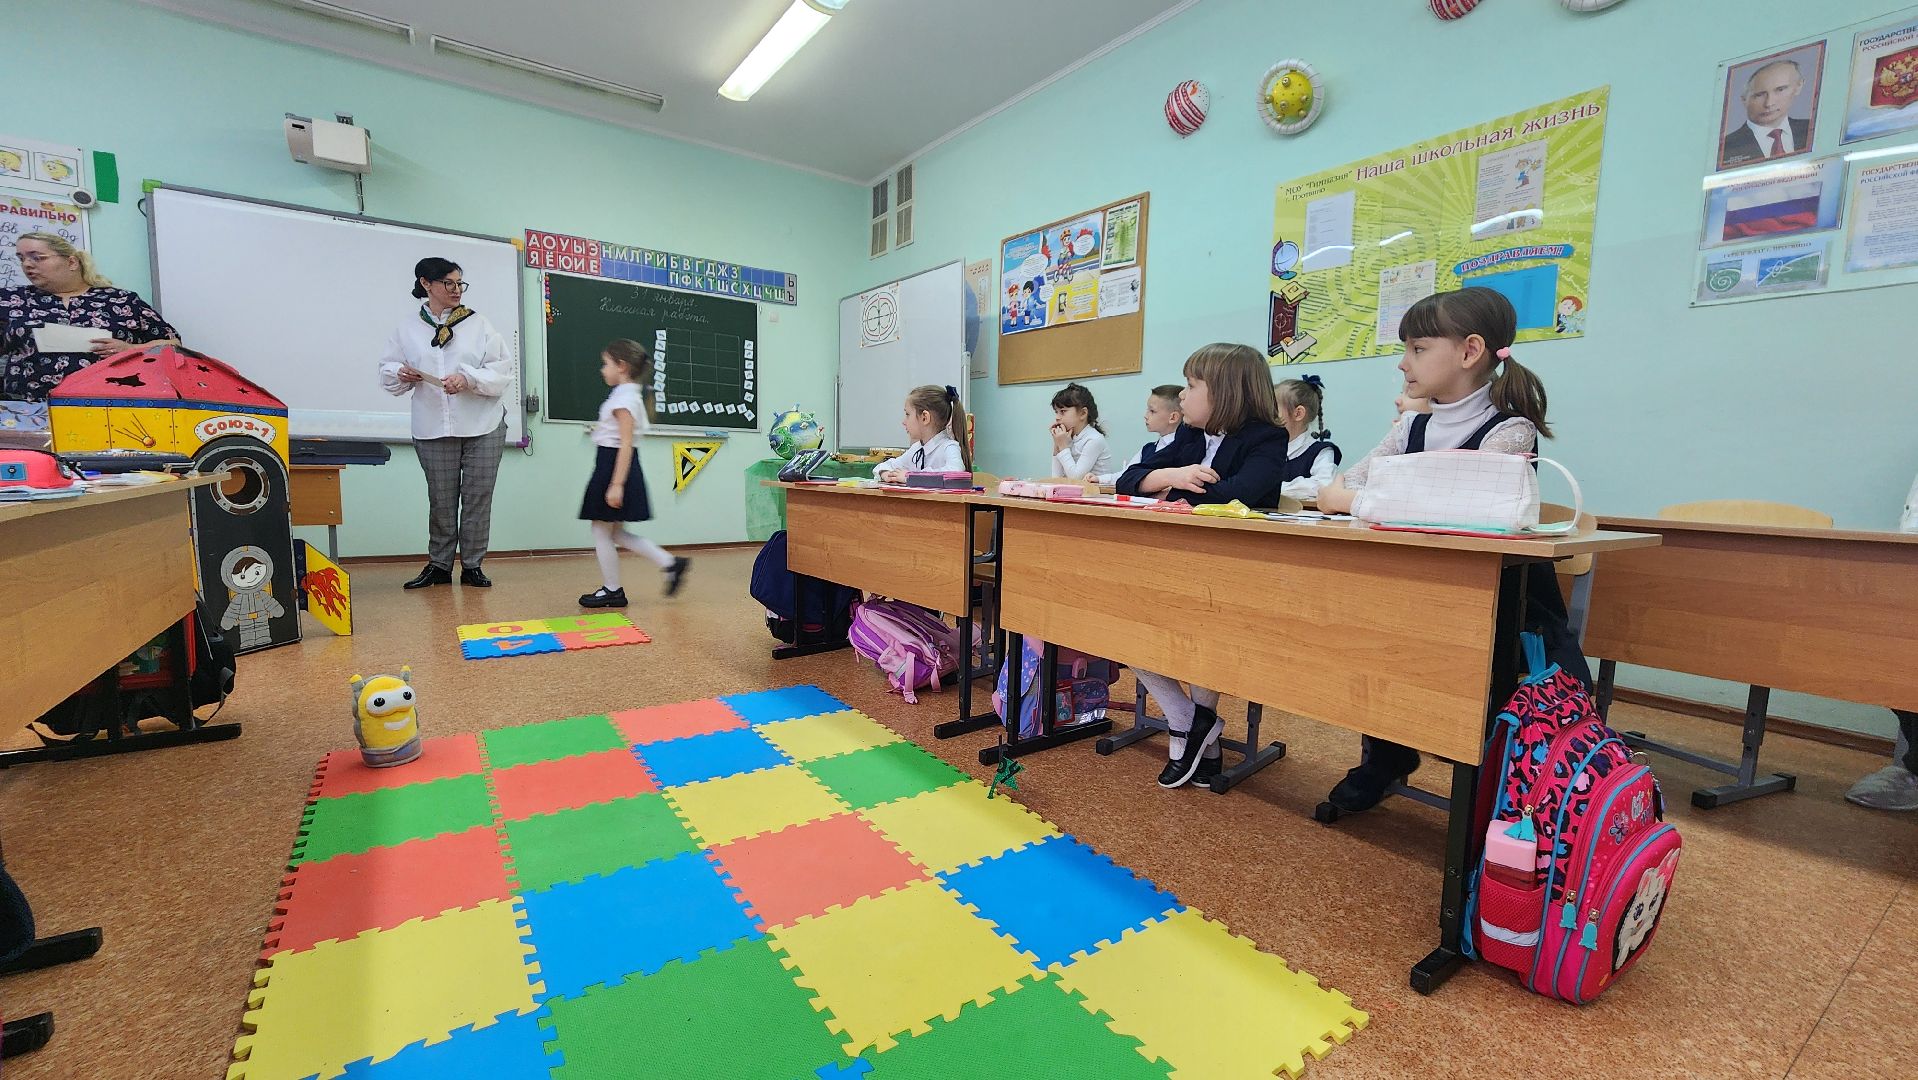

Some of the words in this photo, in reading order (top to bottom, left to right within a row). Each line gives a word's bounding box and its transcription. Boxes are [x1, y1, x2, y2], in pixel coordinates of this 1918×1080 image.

[1356, 159, 1405, 181] Наша
[1412, 127, 1514, 166] школьная
[1522, 103, 1601, 135] жизнь
[1285, 184, 1304, 196] МОУ
[0, 204, 77, 222] РАВИЛЬНО
[1461, 245, 1564, 273] ПОЗДРАВЛЯЕМ!
[631, 286, 648, 299] 31
